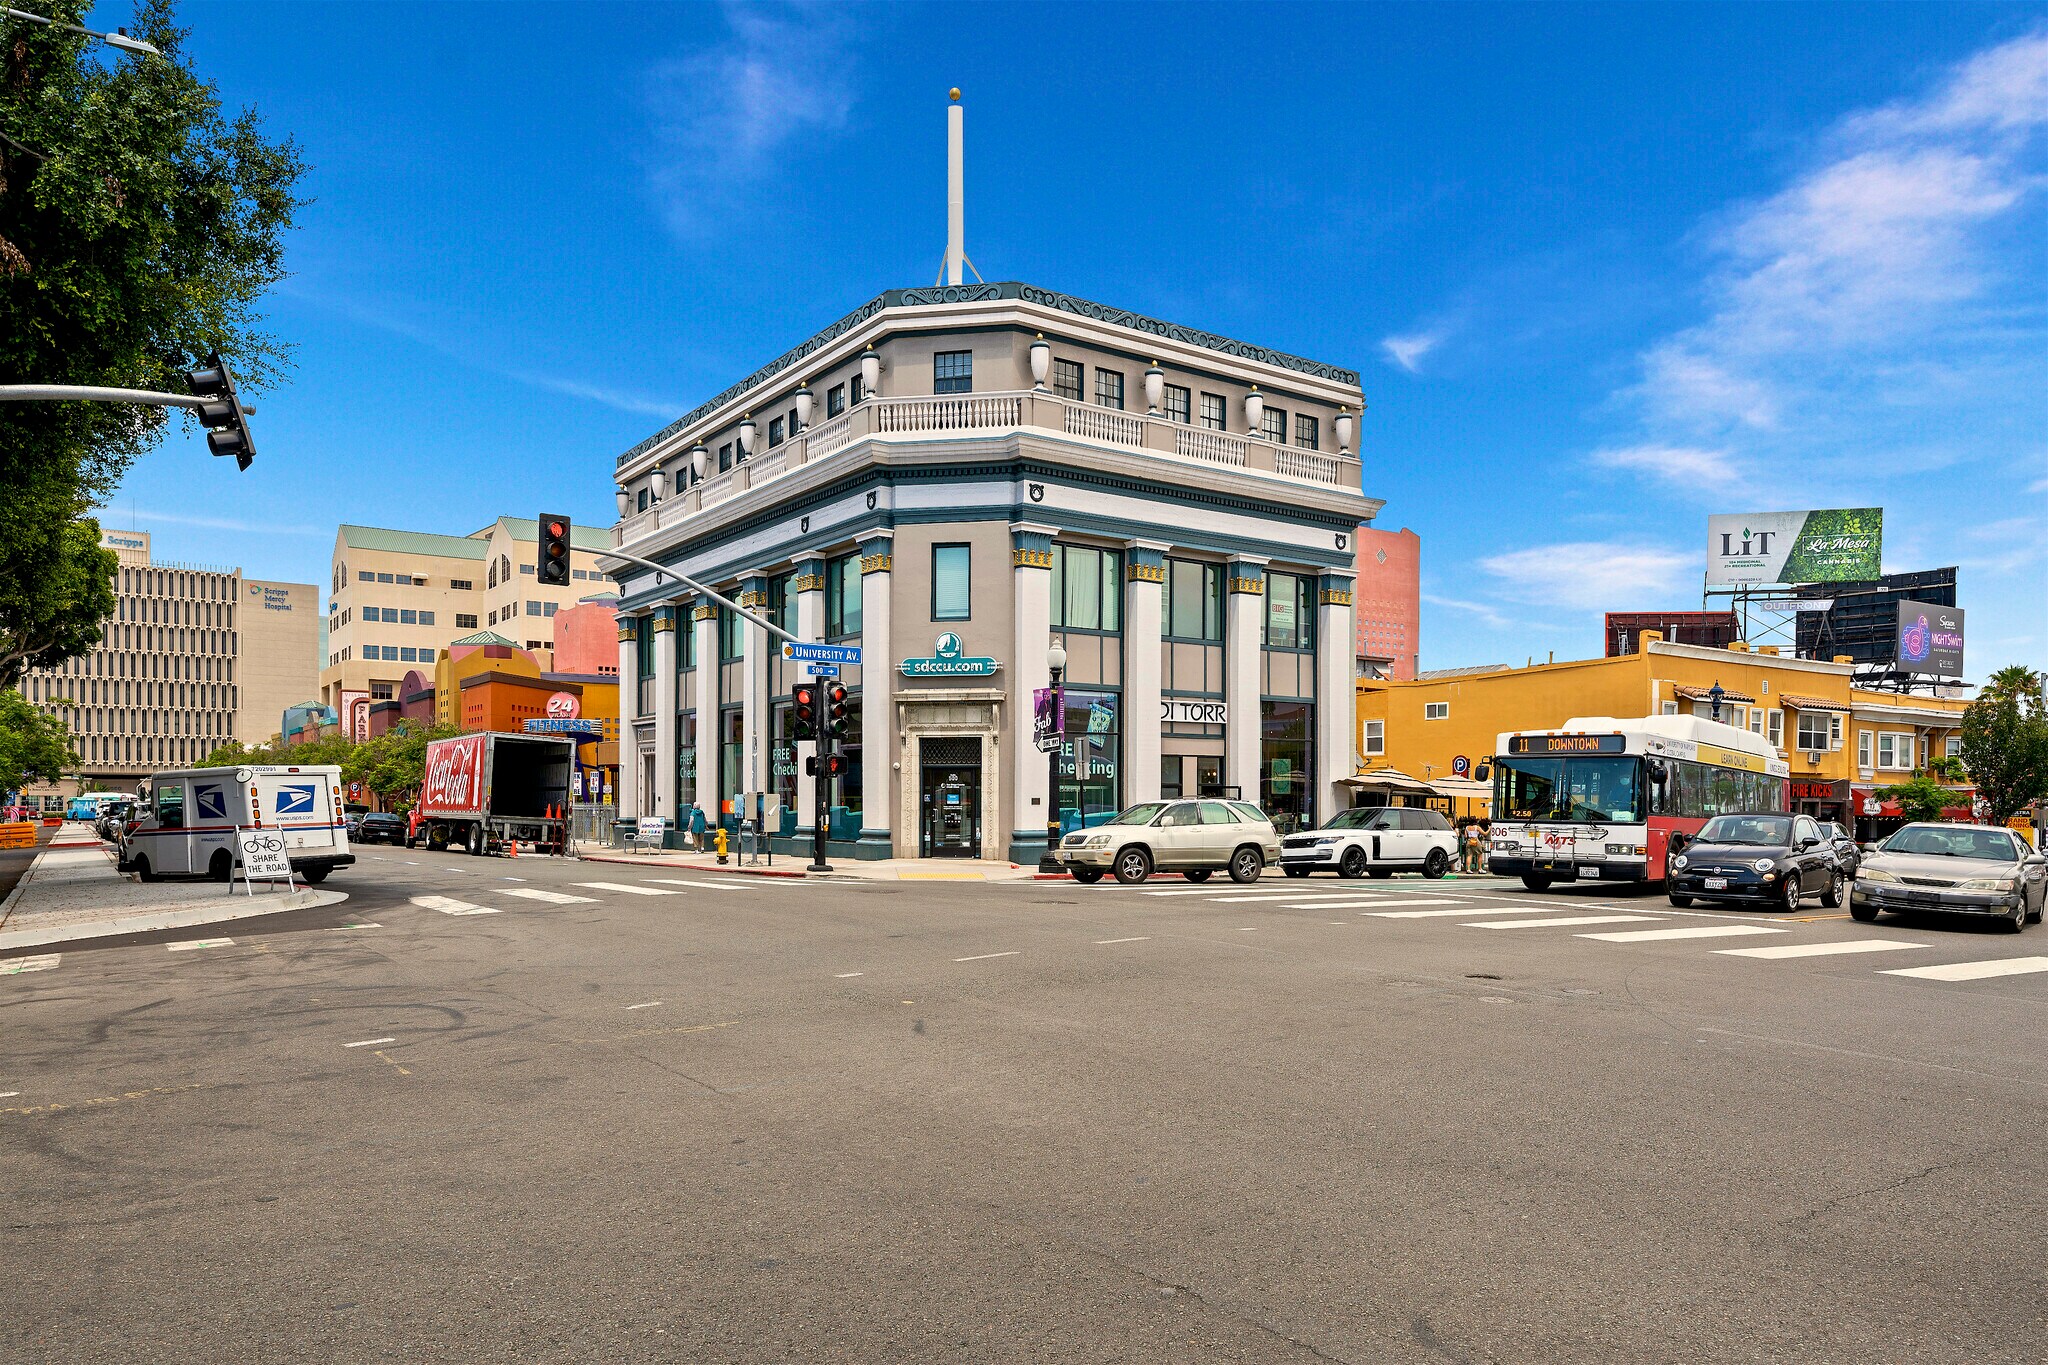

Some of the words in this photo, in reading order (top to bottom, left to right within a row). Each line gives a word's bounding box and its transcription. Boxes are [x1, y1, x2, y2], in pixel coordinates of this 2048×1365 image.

[107, 535, 144, 548] Scripps
[1807, 539, 1828, 553] La
[1830, 537, 1870, 550] Mesa
[264, 587, 289, 597] Scripps
[264, 595, 286, 604] Mercy
[264, 602, 292, 612] Hospital
[1764, 601, 1829, 611] OUTFRONT
[914, 659, 983, 673] sdccu.com
[549, 699, 574, 713] 24
[1180, 703, 1226, 722] TORR
[528, 719, 592, 732] FITNESS
[1034, 713, 1052, 733] Fab
[1043, 740, 1051, 748] ONE
[1519, 738, 1529, 752] 11
[1548, 738, 1599, 751] DOWNTOWN
[680, 754, 693, 766] FREE
[773, 748, 790, 760] FREE
[1457, 760, 1464, 769] P
[1721, 753, 1733, 765] LEARN
[1734, 755, 1748, 768] ONLINE
[1792, 783, 1809, 798] FIRE
[1811, 783, 1833, 798] KICKS
[1512, 809, 1532, 817] $2.50
[1545, 836, 1577, 846] MTS
[252, 853, 279, 863] SHARE
[247, 865, 263, 874] THE
[266, 863, 288, 872] ROAD
